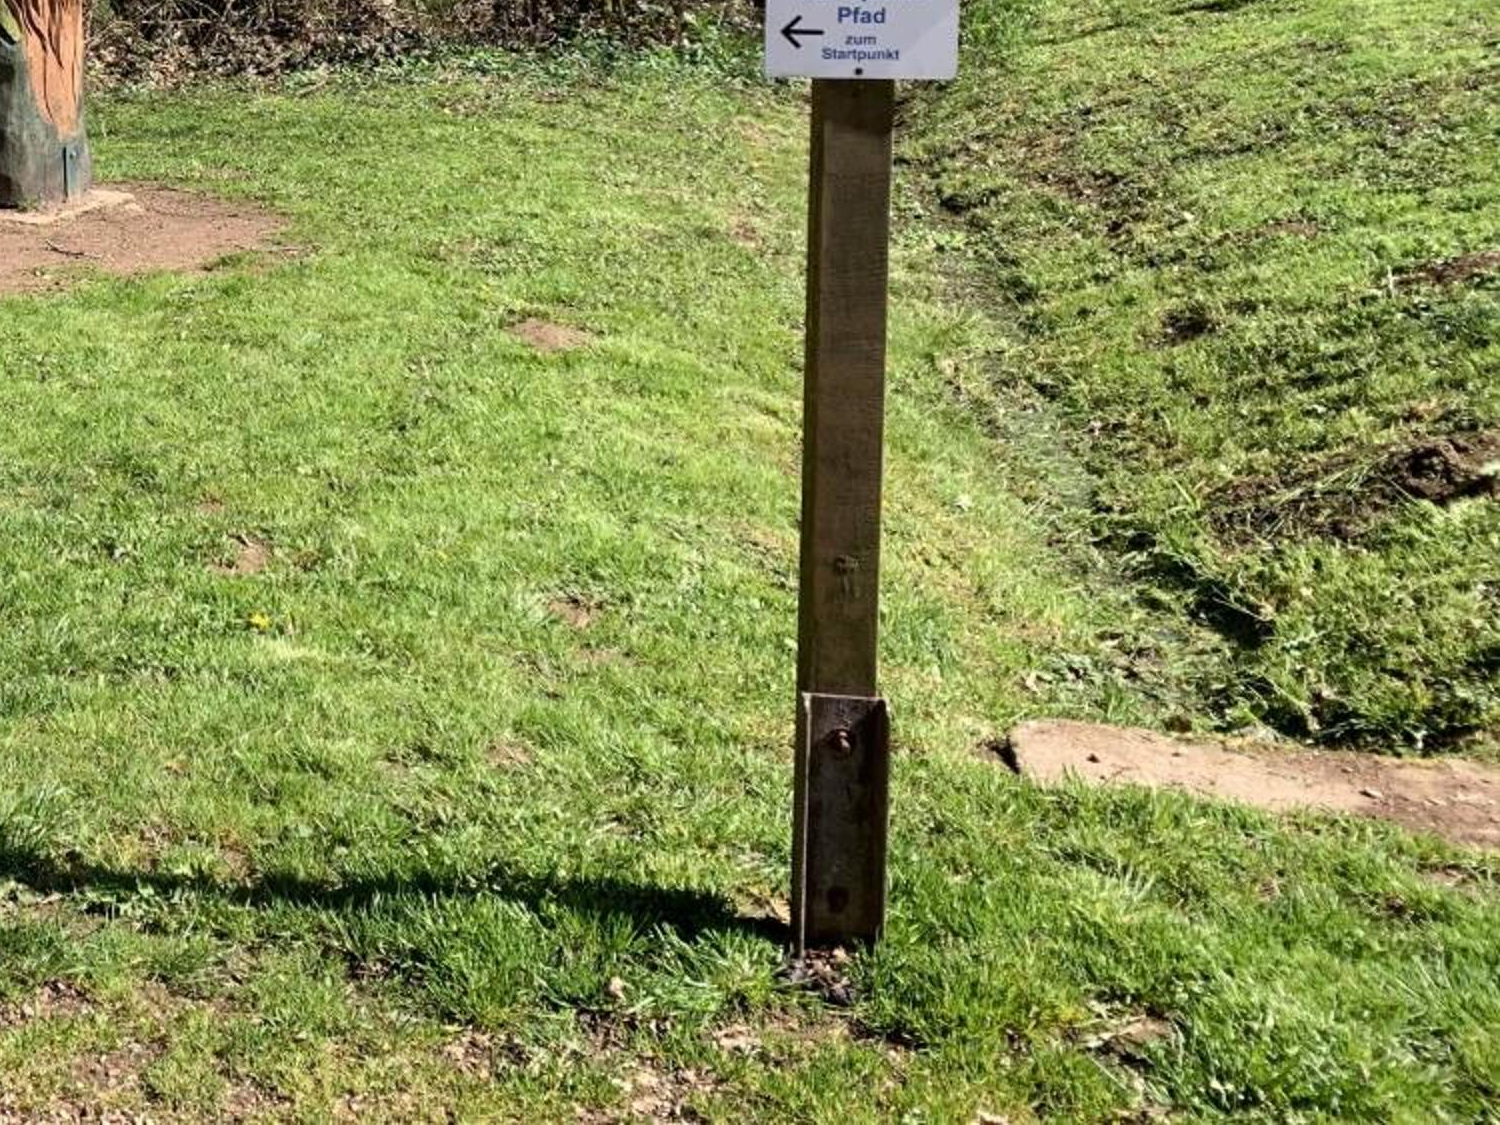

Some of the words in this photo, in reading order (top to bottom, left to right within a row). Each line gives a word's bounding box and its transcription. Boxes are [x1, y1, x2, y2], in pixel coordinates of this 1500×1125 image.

[837, 6, 886, 24] Pfad
[845, 35, 876, 45] zum
[821, 47, 900, 63] Startpunkt
